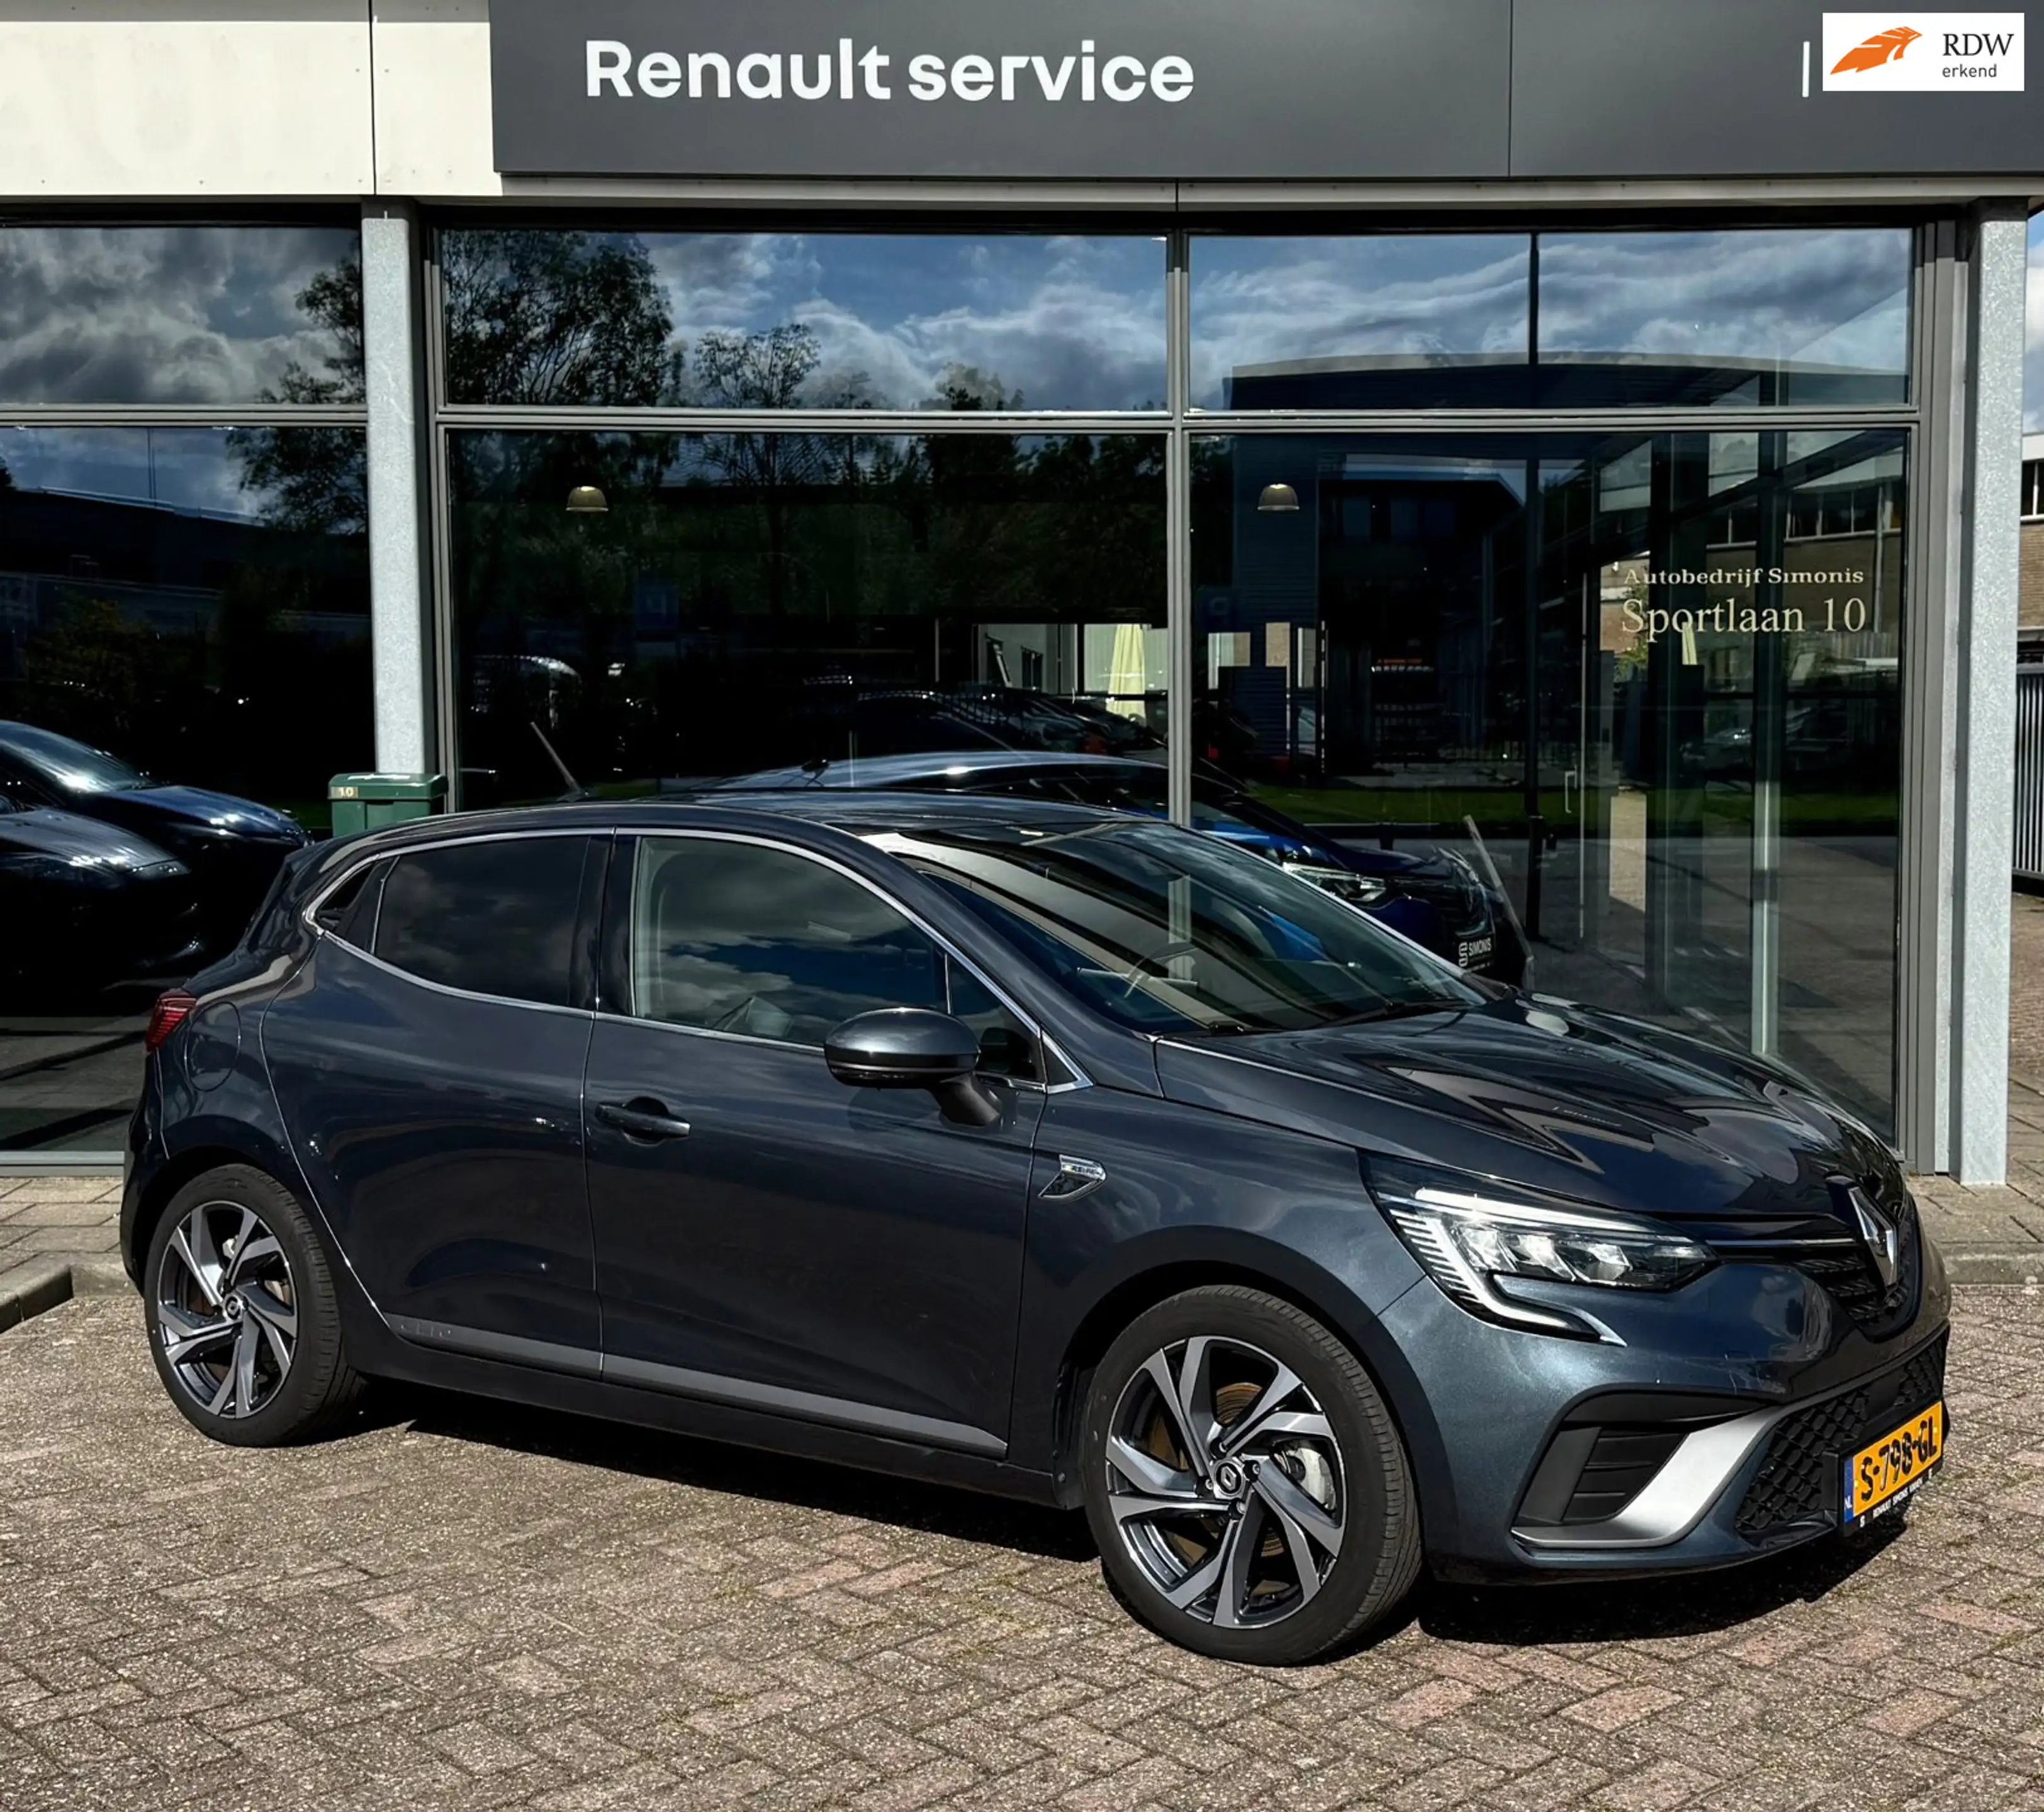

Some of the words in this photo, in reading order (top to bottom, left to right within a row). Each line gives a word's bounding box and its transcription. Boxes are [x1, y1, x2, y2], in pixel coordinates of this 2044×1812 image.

[586, 38, 890, 100] Renault
[907, 40, 1194, 102] service
[1624, 568, 1763, 588] Autobedrijf
[1768, 568, 1864, 584] Simonis
[1622, 597, 1805, 643] Sportlaan
[1824, 597, 1866, 633] 10
[338, 786, 354, 798] 10
[1861, 1416, 1938, 1502] S-798-GL
[1845, 1495, 1853, 1509] NL
